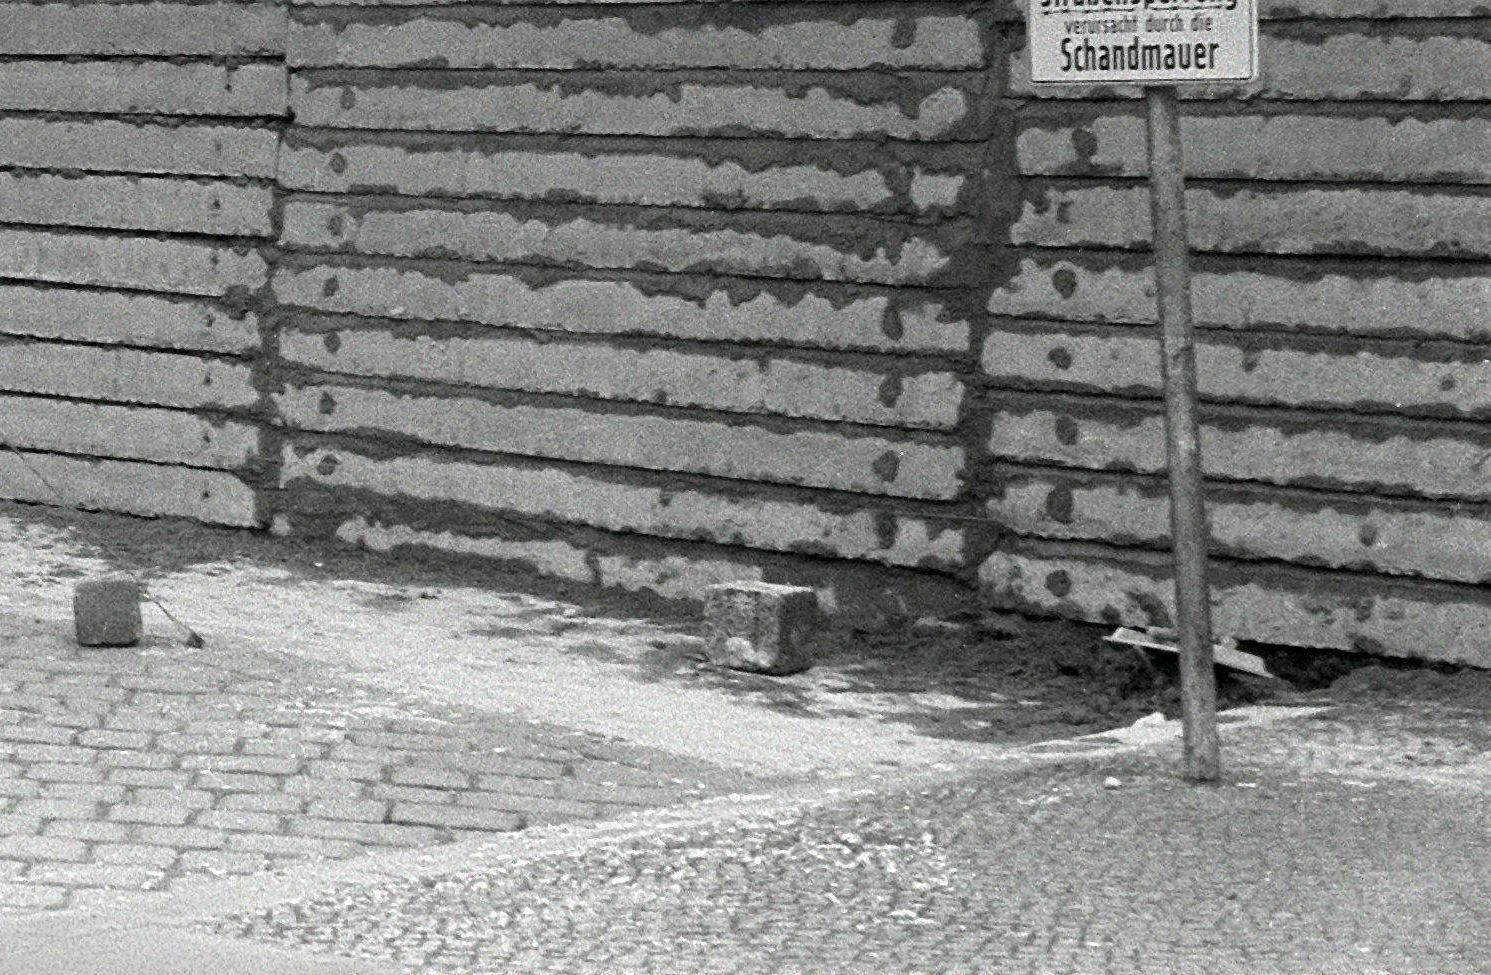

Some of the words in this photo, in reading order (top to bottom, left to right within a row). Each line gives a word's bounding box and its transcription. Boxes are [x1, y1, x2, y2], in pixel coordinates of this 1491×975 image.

[1145, 12, 1184, 33] durch
[1190, 11, 1213, 32] die
[1060, 35, 1220, 72] Schandmauer
